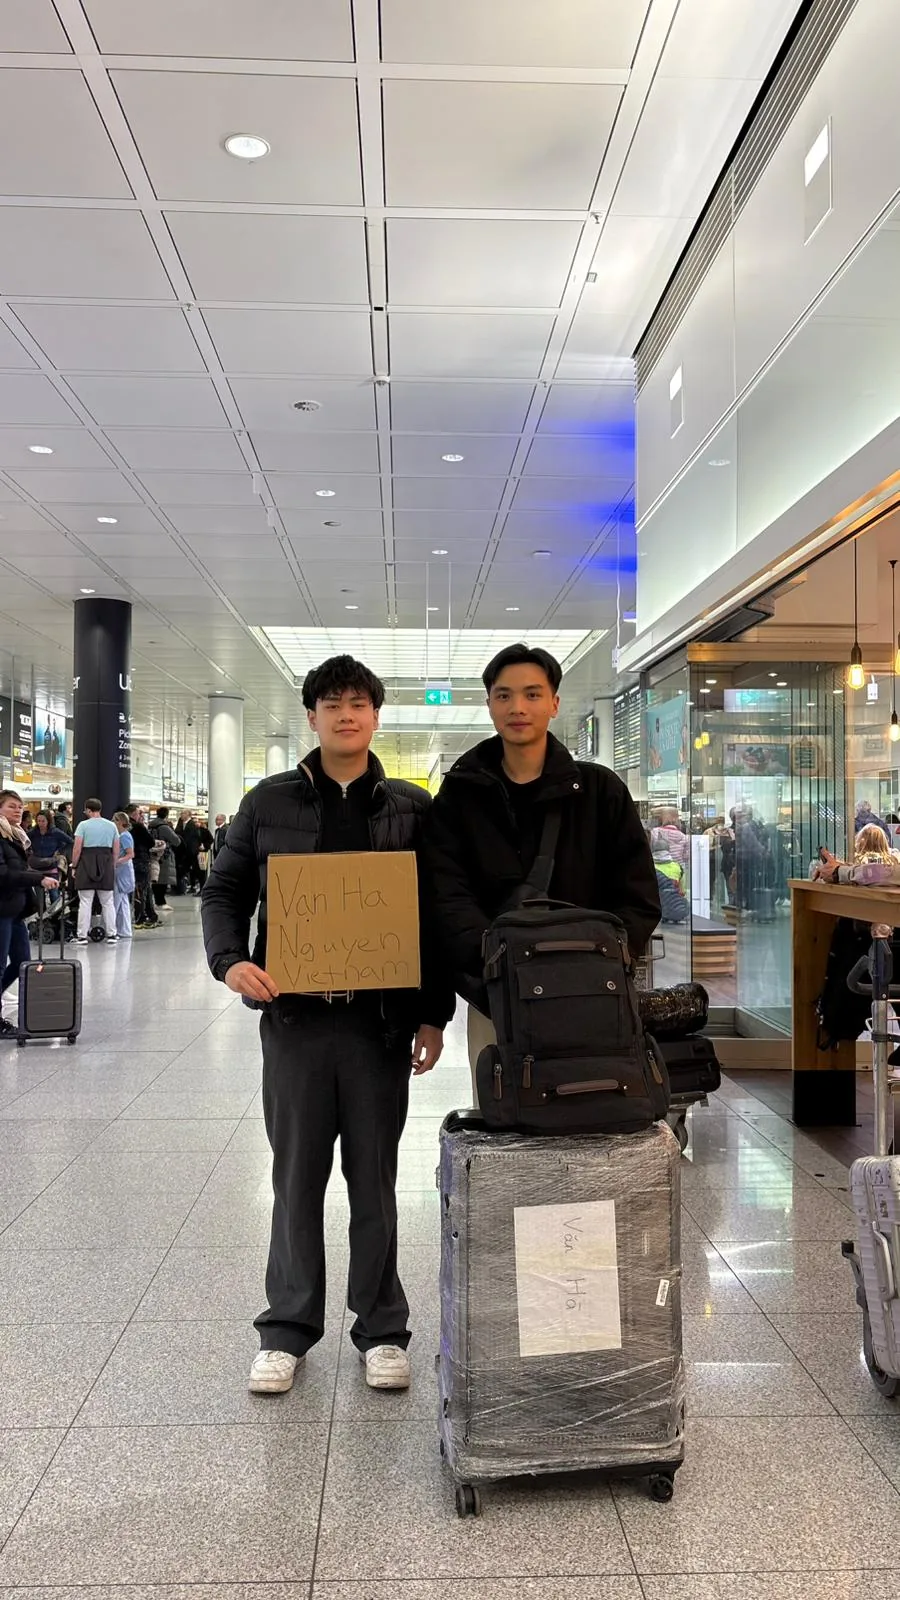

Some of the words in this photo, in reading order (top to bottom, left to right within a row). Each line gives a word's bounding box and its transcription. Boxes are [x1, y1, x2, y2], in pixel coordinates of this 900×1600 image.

[342, 877, 388, 911] Ha
[279, 923, 401, 963] Nguyen
[283, 959, 410, 991] Vietnam
